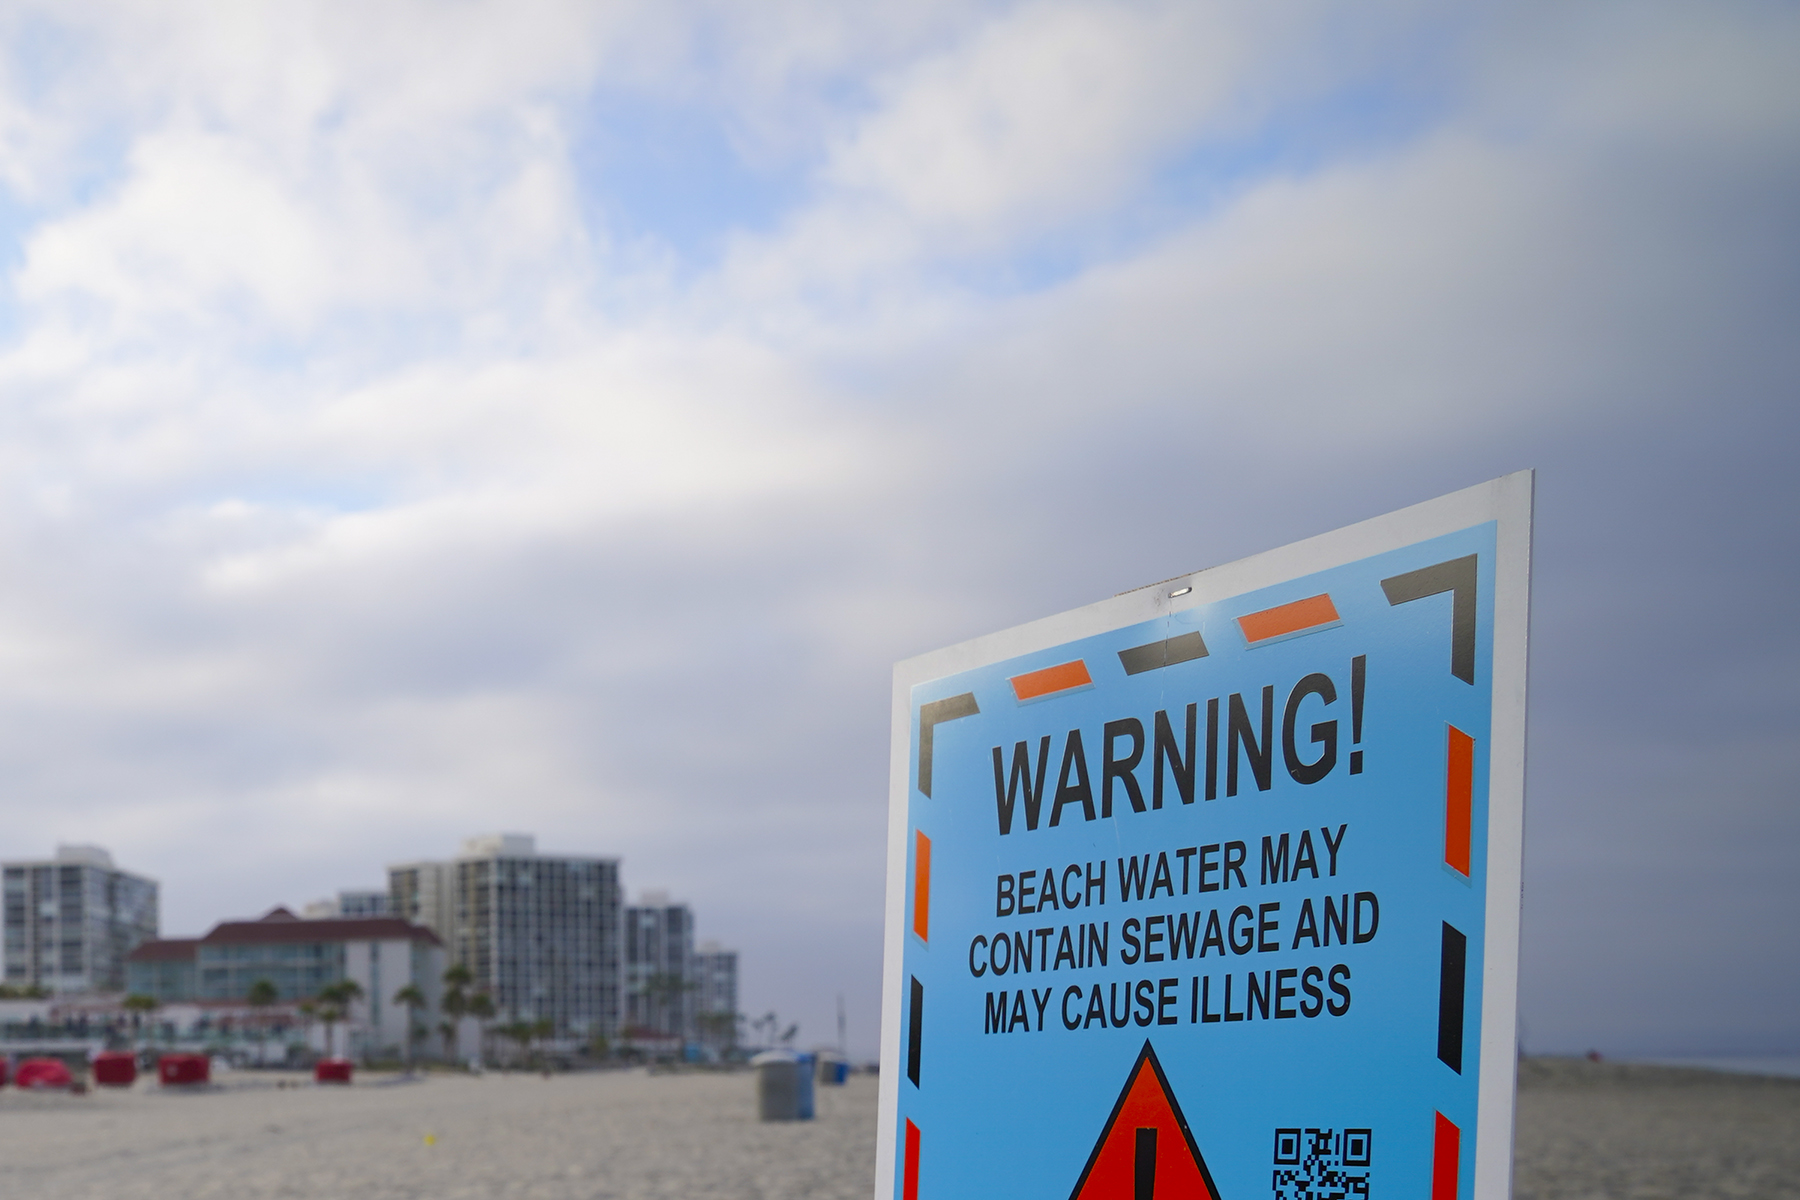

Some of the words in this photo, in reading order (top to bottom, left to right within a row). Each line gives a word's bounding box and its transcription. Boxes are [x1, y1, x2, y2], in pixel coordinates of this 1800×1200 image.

[992, 654, 1367, 836] WARNING!
[996, 860, 1107, 918] BEACH
[1118, 840, 1248, 903] WATER
[1260, 823, 1348, 886] MAY
[969, 921, 1109, 978] CONTAIN
[1120, 901, 1281, 966] SEWAGE
[1291, 891, 1380, 950] AND
[984, 987, 1053, 1035] MAY
[1061, 977, 1179, 1032] CAUSE
[1190, 963, 1352, 1025] ILLNESS
